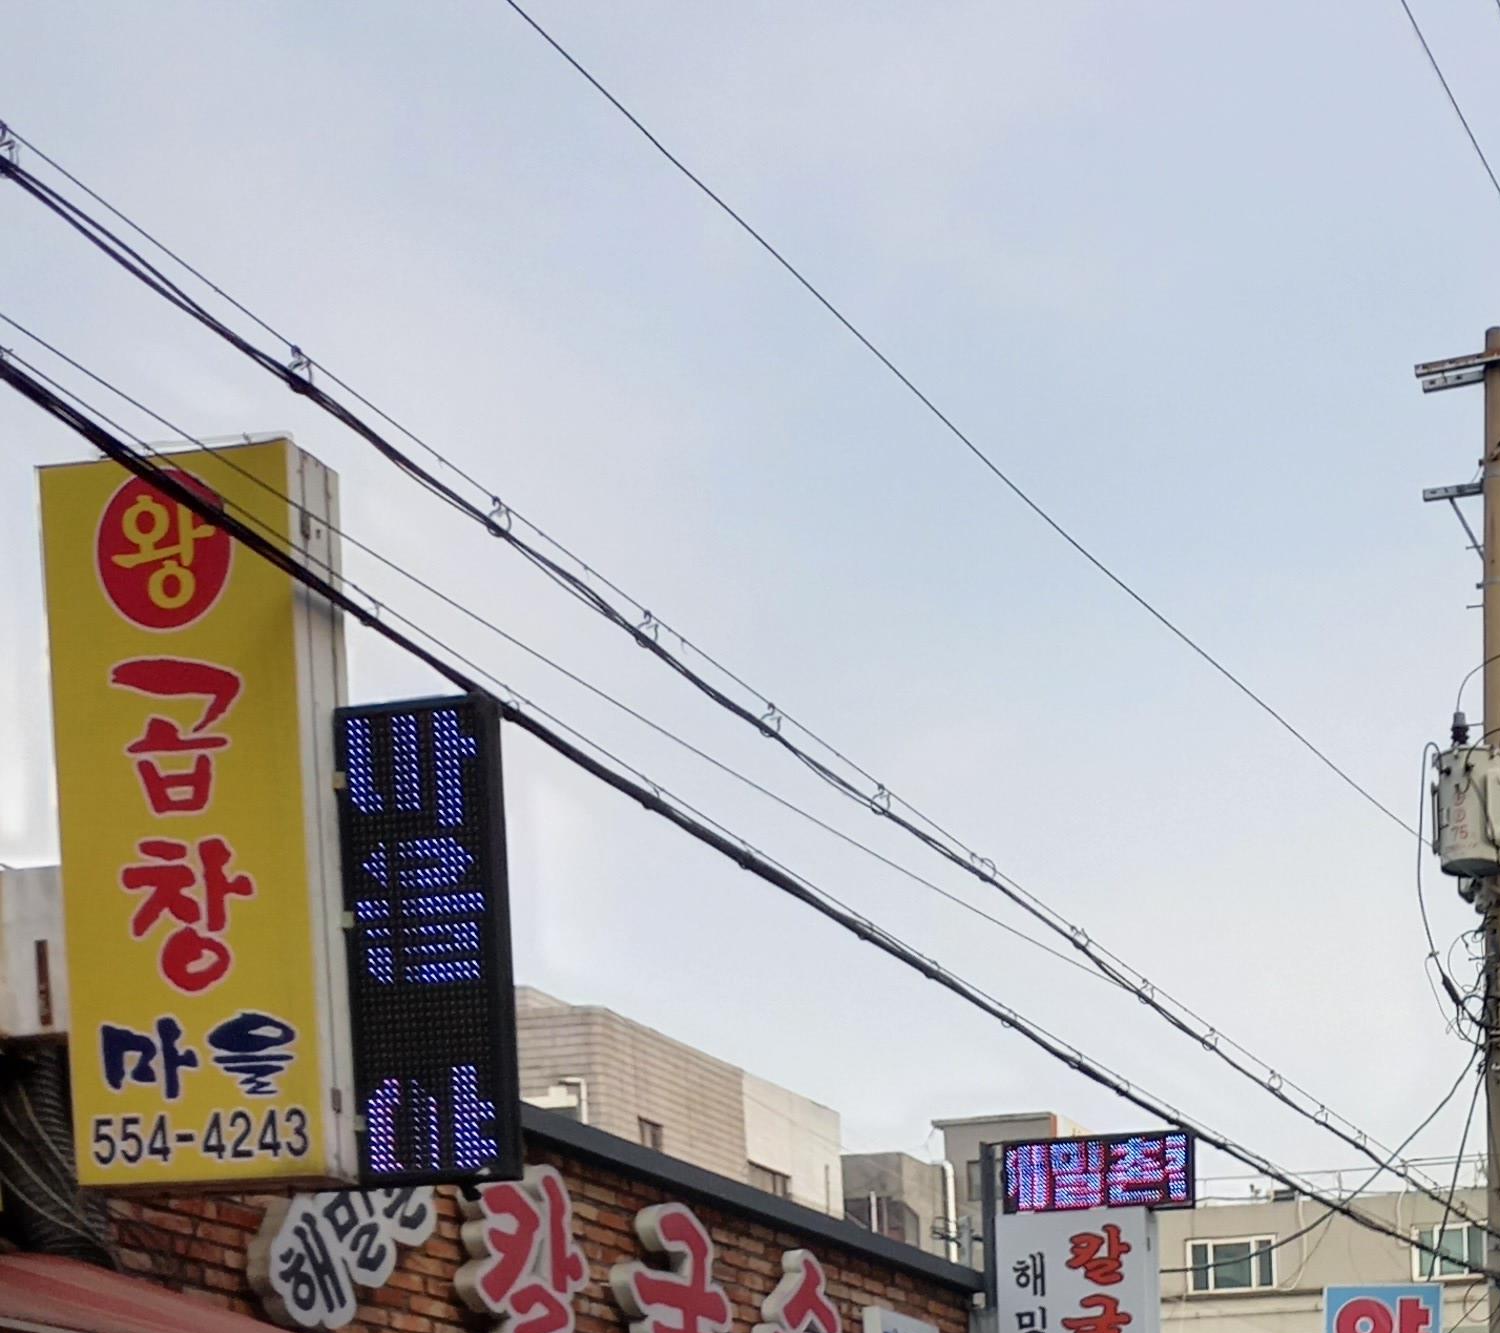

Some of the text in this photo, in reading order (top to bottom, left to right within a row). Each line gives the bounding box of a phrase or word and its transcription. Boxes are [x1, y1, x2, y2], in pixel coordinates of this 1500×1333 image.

[114, 496, 216, 609] 왕
[111, 656, 256, 992] 곱창
[102, 1012, 295, 1099] 마을
[92, 1107, 310, 1164] 554-4243
